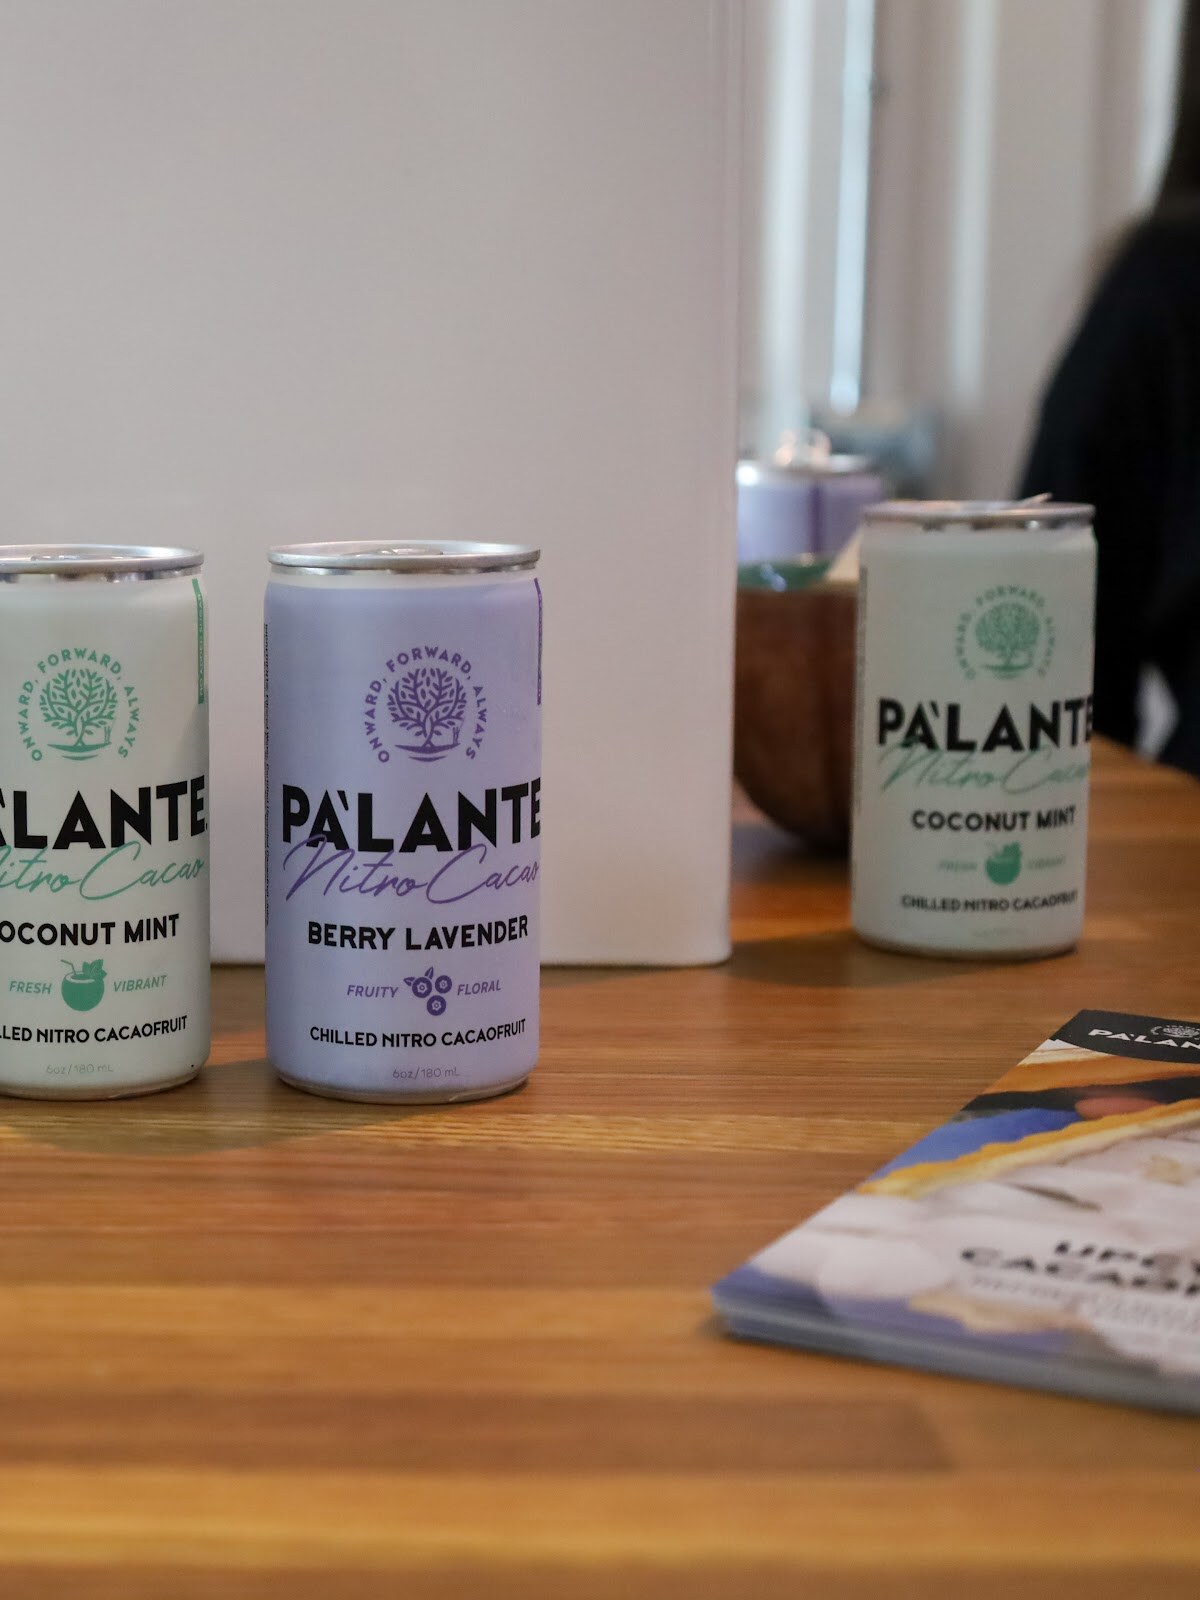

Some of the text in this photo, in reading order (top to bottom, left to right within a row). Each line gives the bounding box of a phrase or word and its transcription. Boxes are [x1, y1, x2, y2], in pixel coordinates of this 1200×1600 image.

[117, 684, 140, 758] ALWAYS
[465, 685, 487, 760] ALWAYS
[912, 804, 1077, 831] COCONUT MINT
[79, 840, 206, 900] Cacao
[283, 833, 540, 904] Nitro Cacao
[964, 898, 1010, 912] NITRO
[124, 913, 180, 943] MINT
[308, 914, 528, 951] BERRY LAVENDER
[9, 974, 167, 995] FRESH VIBRANT
[346, 979, 502, 998] FRUITY FLORAL
[36, 1028, 90, 1043] NITRO
[94, 1015, 188, 1042] CACAOFRUIT
[310, 1018, 526, 1048] CHILLED NITRO CACAOFRUIT
